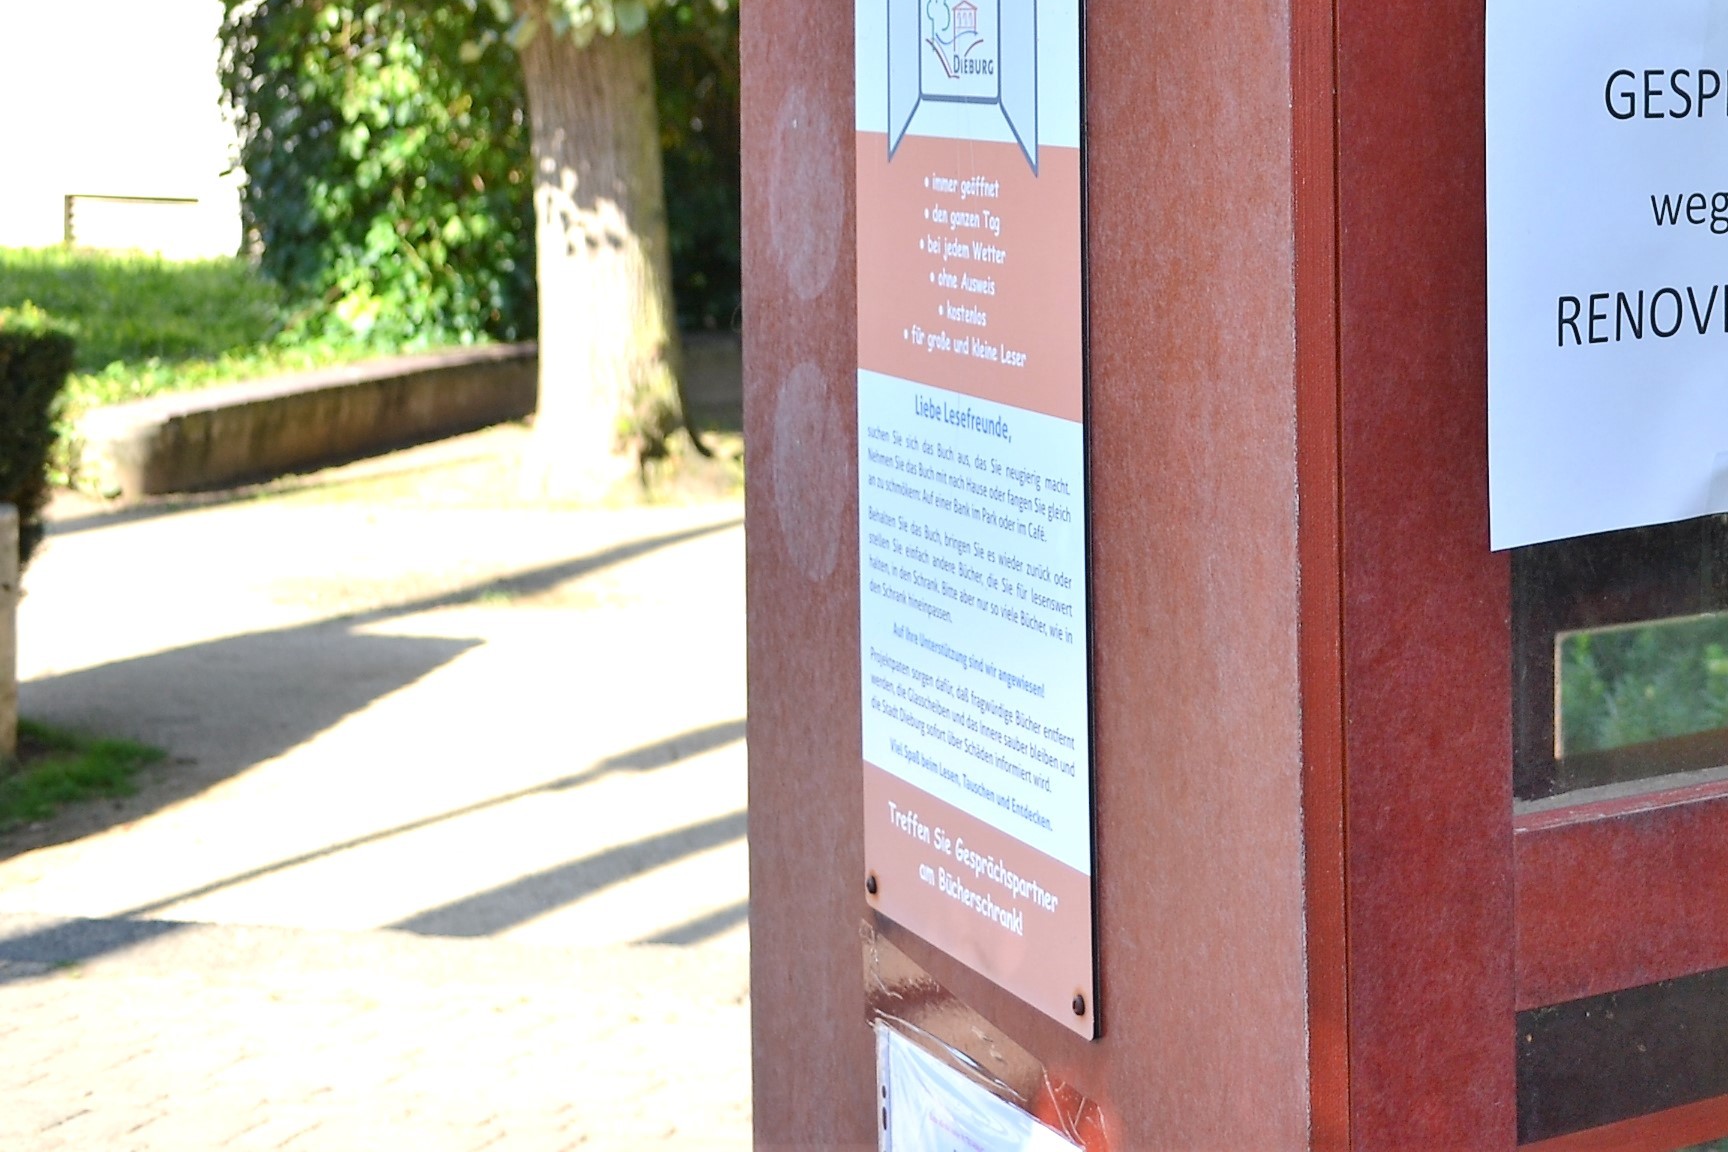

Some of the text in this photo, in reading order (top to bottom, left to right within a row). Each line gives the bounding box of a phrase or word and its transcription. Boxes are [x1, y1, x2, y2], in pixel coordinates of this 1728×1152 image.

[932, 173, 999, 199] immer geöffnet
[932, 203, 1000, 237] den ganzen Tag
[927, 234, 1006, 264] bei jedem Wetter
[938, 267, 995, 296] ohne Ausweis
[911, 325, 1026, 367] für große und kleine Leser
[946, 300, 987, 327] kostenlos
[914, 394, 1012, 442] Liebe Lesefreunde,
[867, 426, 1070, 495] suchen Sie sich das Buch aus, das Sie neugierig macht.
[867, 447, 1071, 522] Nehmen Sie das Buch mit nach Hause oder fangen Sie gleich
[867, 474, 876, 486] an
[876, 477, 884, 489] zu
[921, 488, 934, 505] Auf
[934, 493, 952, 511] einer
[953, 498, 970, 517] Bank
[971, 503, 980, 520] im
[981, 507, 997, 525] Park
[997, 513, 1015, 531] oder
[1016, 518, 1026, 535] im
[1027, 521, 1047, 542] Café.
[892, 538, 903, 554] Sie
[931, 555, 956, 574] andere
[958, 561, 983, 587] Bücher,
[986, 571, 998, 589] die
[1001, 577, 1013, 595] Sie
[1016, 582, 1027, 600] für
[1030, 588, 1072, 617] lesenswert
[897, 515, 908, 532] Sie
[909, 519, 922, 537] das
[924, 524, 942, 547] Buch,
[944, 531, 970, 556] bringen
[973, 541, 984, 559] Sie
[986, 549, 995, 562] es
[997, 552, 1023, 572] wieder
[1025, 563, 1051, 582] zurück
[1053, 570, 1072, 589] oder
[869, 577, 881, 594] den
[881, 582, 906, 604] Schrank
[891, 561, 897, 576] in
[898, 564, 912, 582] den
[912, 569, 940, 593] Schrank.
[941, 580, 958, 600] Bitte
[959, 588, 975, 606] aber
[976, 597, 988, 611] nur
[989, 602, 999, 615] so
[1000, 604, 1018, 623] viele
[1020, 610, 1047, 637] Bücher,
[1048, 623, 1063, 640] wie
[1064, 627, 1073, 644] in
[893, 621, 904, 638] Auf
[968, 654, 984, 672] sind
[984, 662, 997, 678] wir
[998, 669, 1045, 698] angewiesen!
[870, 694, 1052, 792] die Stadt Dieburg sofort über Schäden informiert wird.
[895, 681, 906, 699] die
[951, 710, 965, 726] und
[965, 713, 978, 732] das
[979, 720, 1002, 743] Innere
[1003, 734, 1028, 755] sauber
[1029, 743, 1059, 770] bleiben
[1059, 760, 1075, 777] und
[911, 668, 933, 689] sorgen
[934, 675, 954, 699] dafür,
[955, 684, 969, 703] daß
[1014, 710, 1041, 735] Bücher
[1042, 726, 1075, 750] entfernt
[889, 737, 1053, 831] Viel Spaß beim Lesen, Tauschen und Entdecken.
[888, 801, 1058, 914] Treffen Sie Gesprächspartner
[919, 862, 1024, 937] am Bücherschrank!
